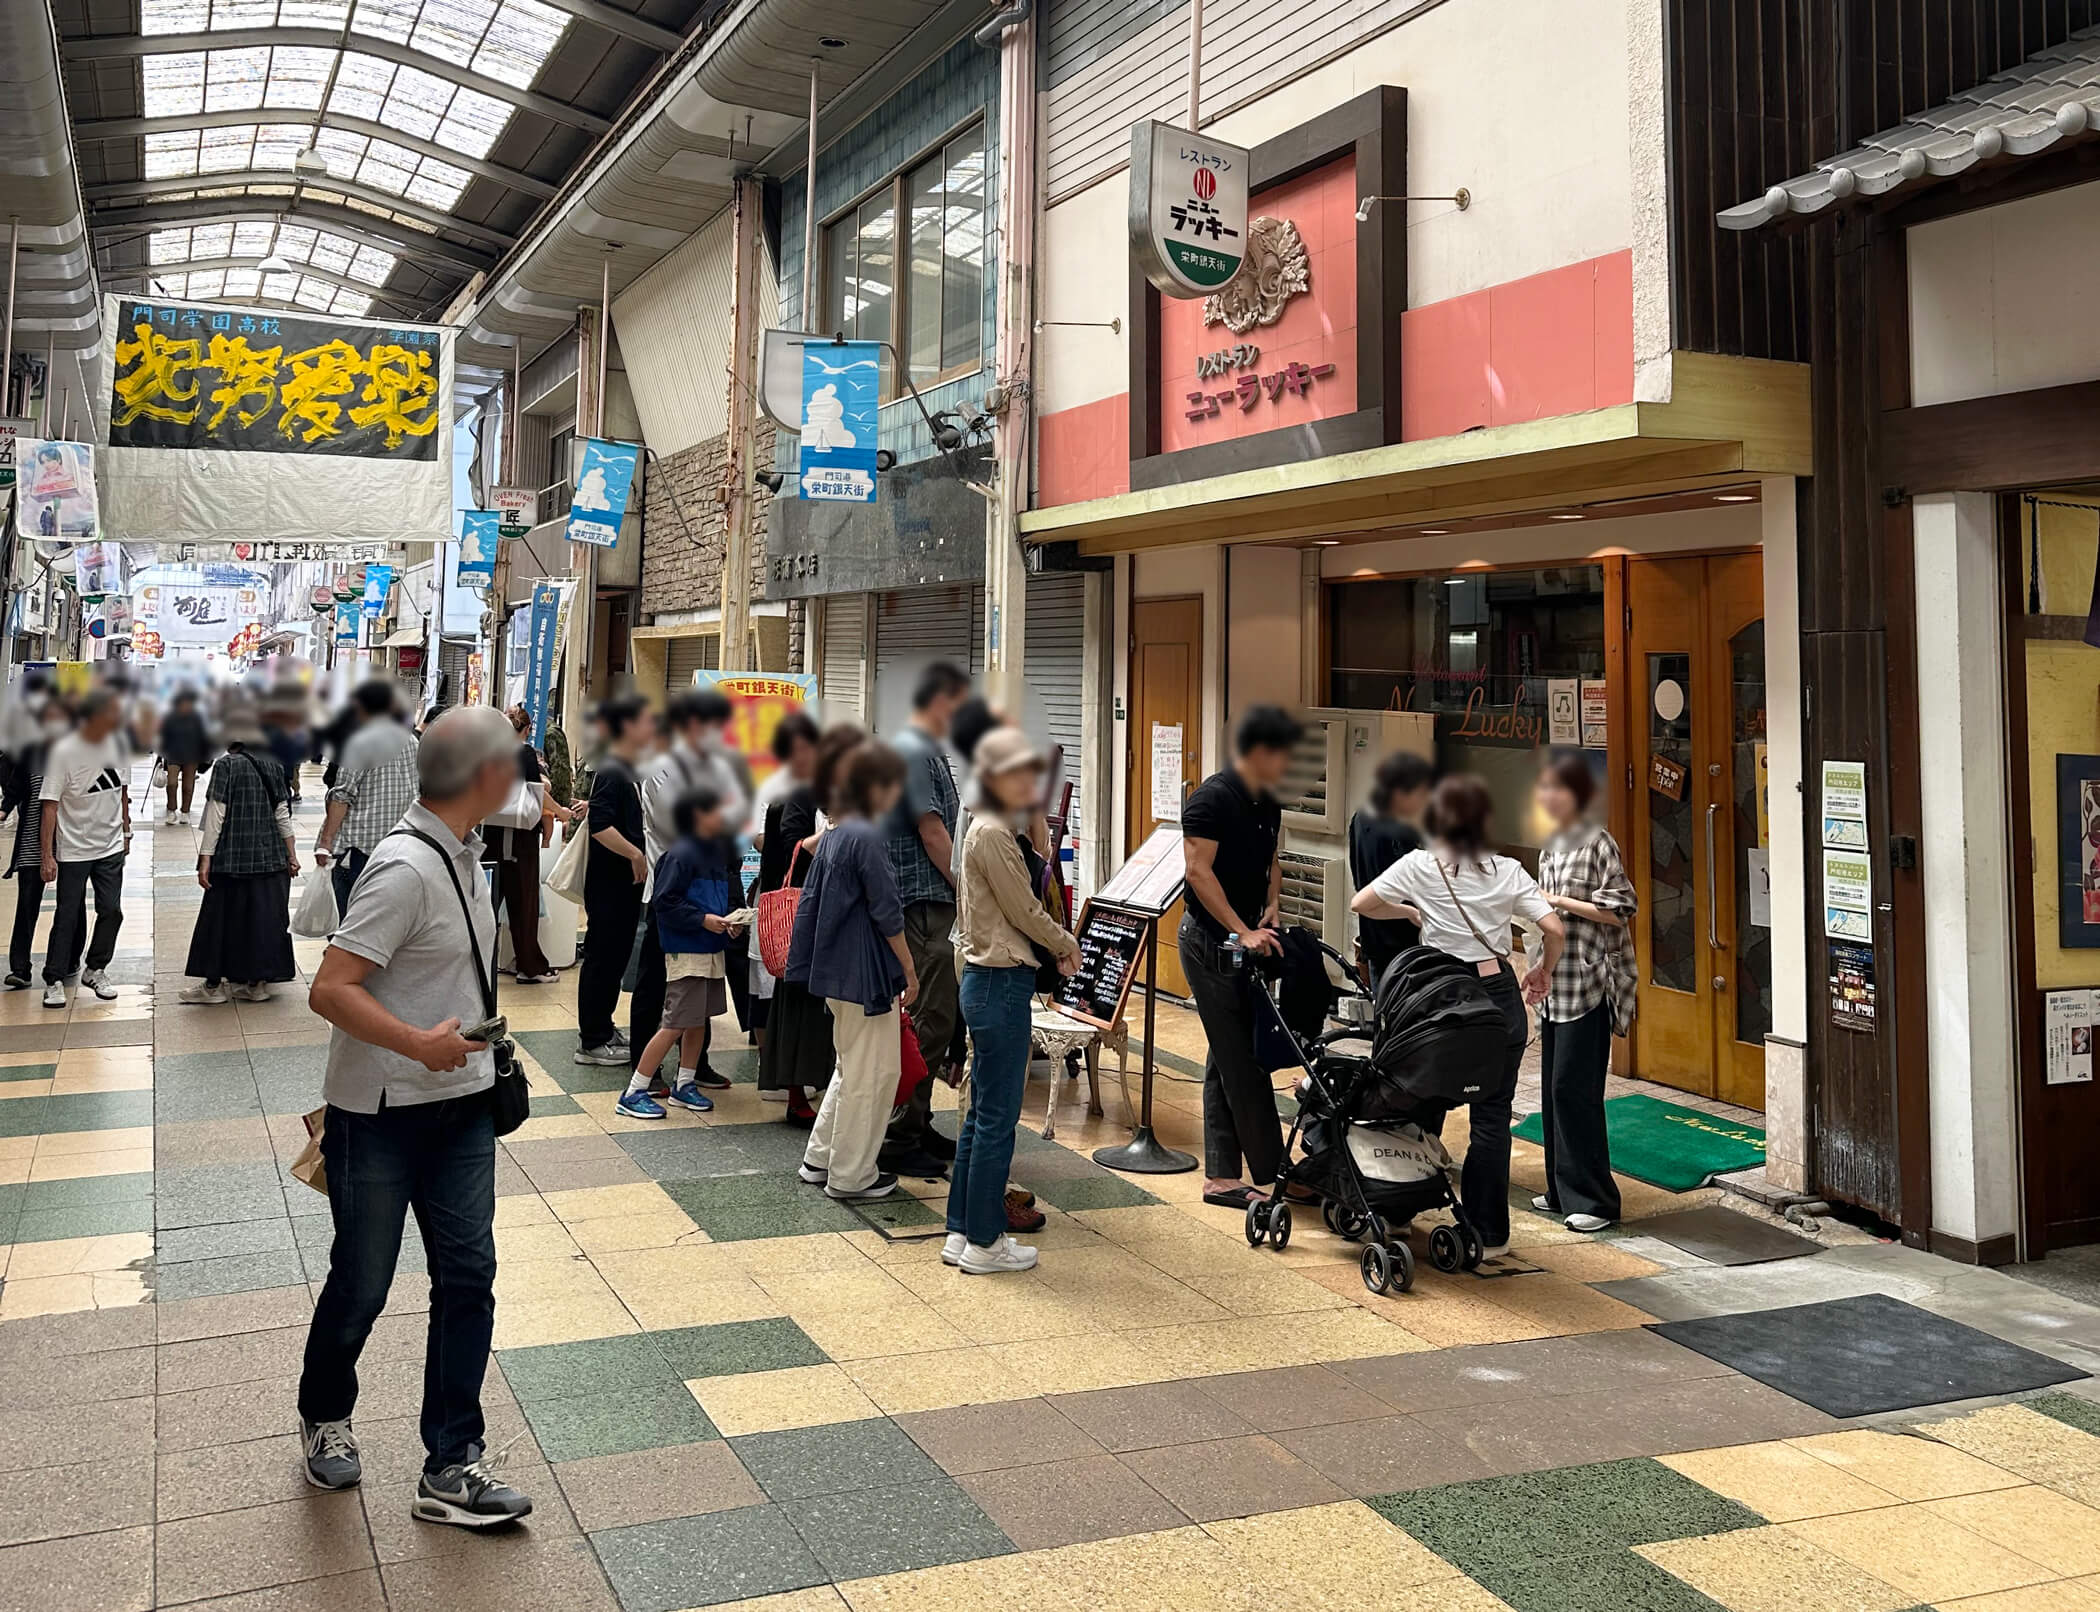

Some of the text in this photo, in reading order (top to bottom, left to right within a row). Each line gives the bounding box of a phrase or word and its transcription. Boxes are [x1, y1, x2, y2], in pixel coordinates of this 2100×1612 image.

[1180, 147, 1232, 172] レストラン
[1196, 169, 1215, 200] NL
[1187, 199, 1219, 214] ニュー
[1170, 206, 1238, 241] ラッキー
[1180, 250, 1227, 273] 栄町銀天街
[132, 305, 282, 337] 門司学園高校
[1196, 343, 1260, 379] レストラン
[1185, 361, 1335, 423] ニューラッキー
[825, 471, 851, 481] 門司港
[811, 481, 865, 497] 栄町銀天街
[506, 509, 520, 522] 匠
[1450, 684, 1543, 751] Lucky
[1373, 1148, 1412, 1160] DEAN
